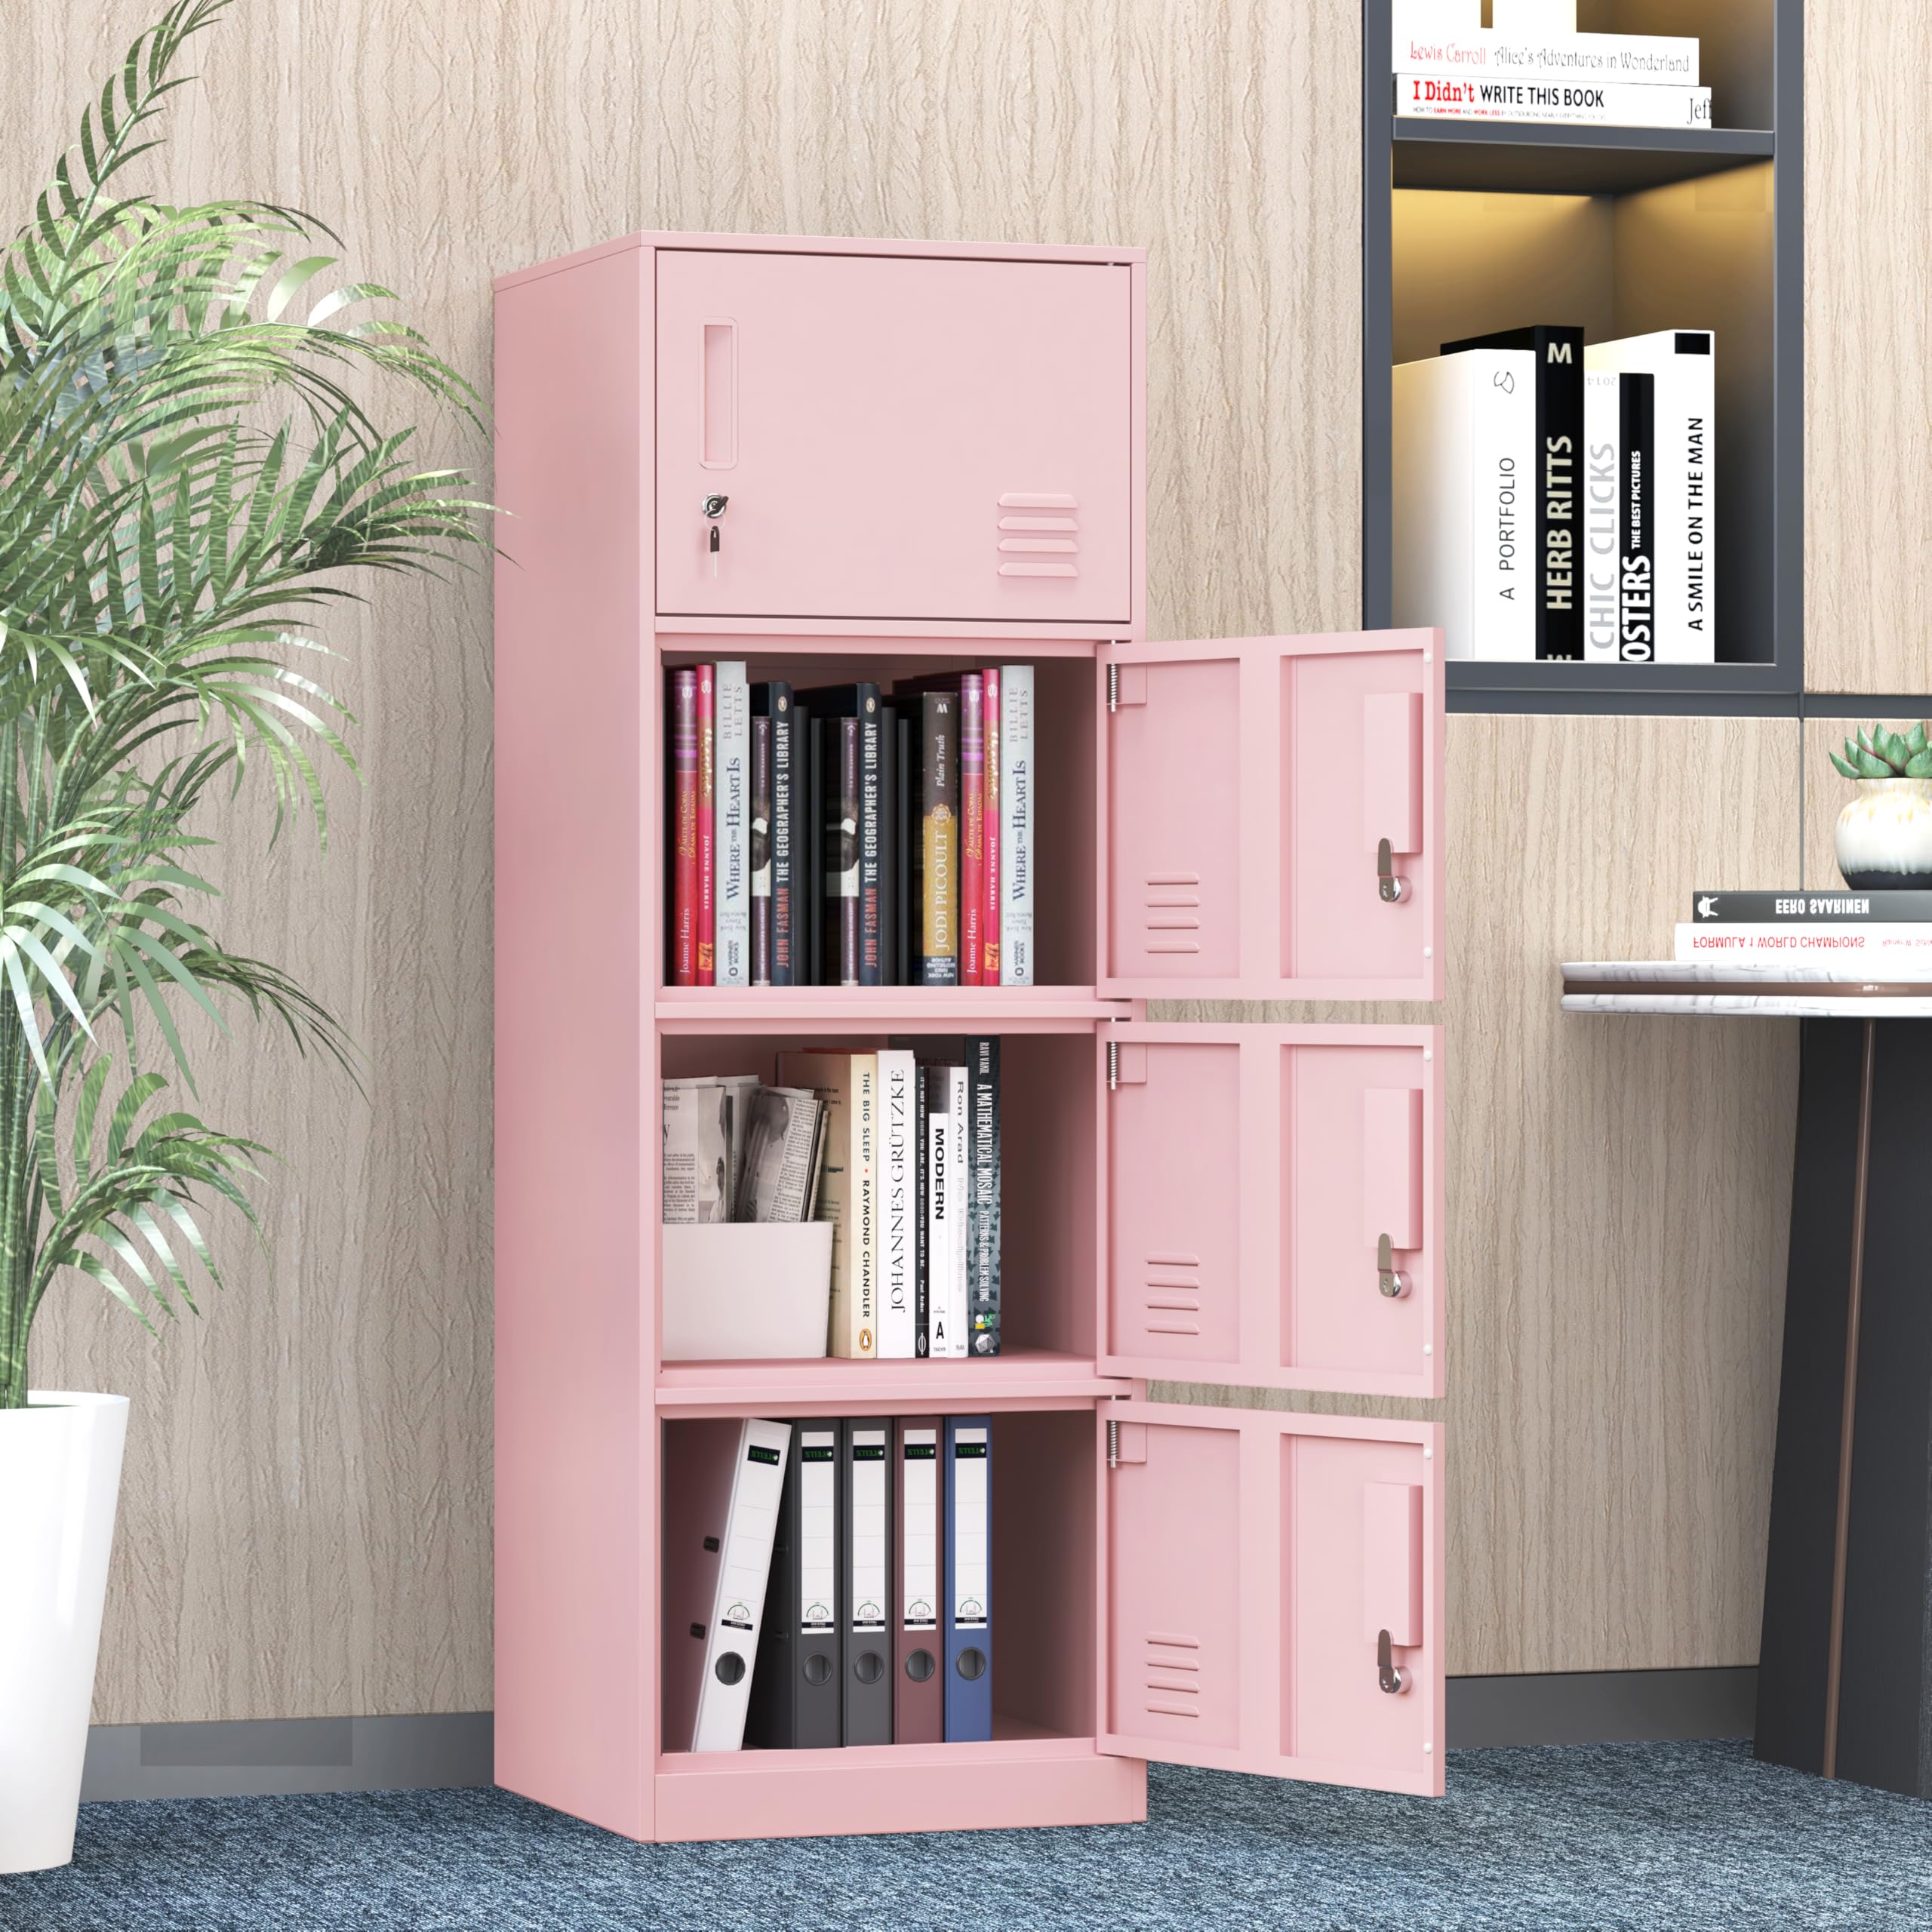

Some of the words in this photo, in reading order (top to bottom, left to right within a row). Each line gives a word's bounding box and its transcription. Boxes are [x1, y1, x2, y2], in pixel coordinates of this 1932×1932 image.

[1411, 41, 1442, 60] Lewis
[1447, 43, 1486, 65] Carroll
[1494, 46, 1534, 66] Alice's
[1537, 48, 1603, 68] Adventures
[1607, 52, 1617, 69] in
[1621, 52, 1689, 72] Wonderland
[1414, 81, 1420, 100] I
[1425, 80, 1475, 103] Didn't
[1480, 85, 1523, 104] WRITE
[1527, 87, 1559, 106] THIS
[1564, 88, 1604, 107] BOOK
[1547, 343, 1572, 364] M
[1688, 418, 1703, 464] MAN
[1547, 436, 1572, 519] RITTS
[1631, 451, 1641, 500] PICTURES
[1688, 472, 1703, 509] THE
[1500, 458, 1515, 571] PORTFOLIO
[1589, 444, 1614, 555] CLICKS
[1631, 502, 1641, 527] BEST
[1631, 530, 1641, 549] THE
[1688, 517, 1703, 544] ON
[1547, 530, 1572, 609] HERB
[1688, 552, 1703, 612] SMILE
[1500, 588, 1515, 600] A
[1589, 574, 1614, 649] CHIC
[1688, 619, 1703, 631] A
[723, 684, 731, 739] BILLIE
[734, 686, 743, 737] LETTS
[1010, 688, 1018, 742] BILLIE
[777, 722, 789, 768] LIBRARY
[865, 722, 877, 768] LIBRARY
[935, 734, 946, 760] Truth
[935, 762, 946, 786] Plain
[726, 774, 740, 826] HEART
[777, 774, 789, 857] GEOGRAPHER'S
[865, 774, 877, 857] GEOGRAPHER'S
[1013, 777, 1026, 829] HEART
[726, 844, 740, 900] WHERE
[777, 863, 789, 882] THE
[865, 863, 877, 882] THE
[935, 831, 948, 905] PICOULT
[1013, 845, 1026, 901] WHERE
[680, 908, 690, 939] Harris
[777, 888, 789, 933] FASMAN
[865, 888, 877, 933] FASMAN
[935, 909, 949, 952] JODI
[967, 909, 977, 940] Harris
[680, 943, 690, 974] Joanne
[777, 939, 789, 967] JOHN
[865, 939, 877, 967] JOHN
[967, 943, 977, 974] Joanne
[980, 1042, 989, 1056] RAVI
[980, 1057, 989, 1075] VAKIL
[889, 1069, 904, 1183] GRÜTZKE
[977, 1093, 992, 1163] MATHEMATICAL
[936, 1129, 945, 1220] MODERN
[977, 1168, 992, 1204] MOSAIC
[980, 1211, 989, 1241] PATTERNS
[891, 1188, 905, 1313] JOHANNES
[980, 1248, 989, 1275] PROBLEM
[979, 1276, 989, 1301] SOLVING
[936, 1321, 944, 1339] A
